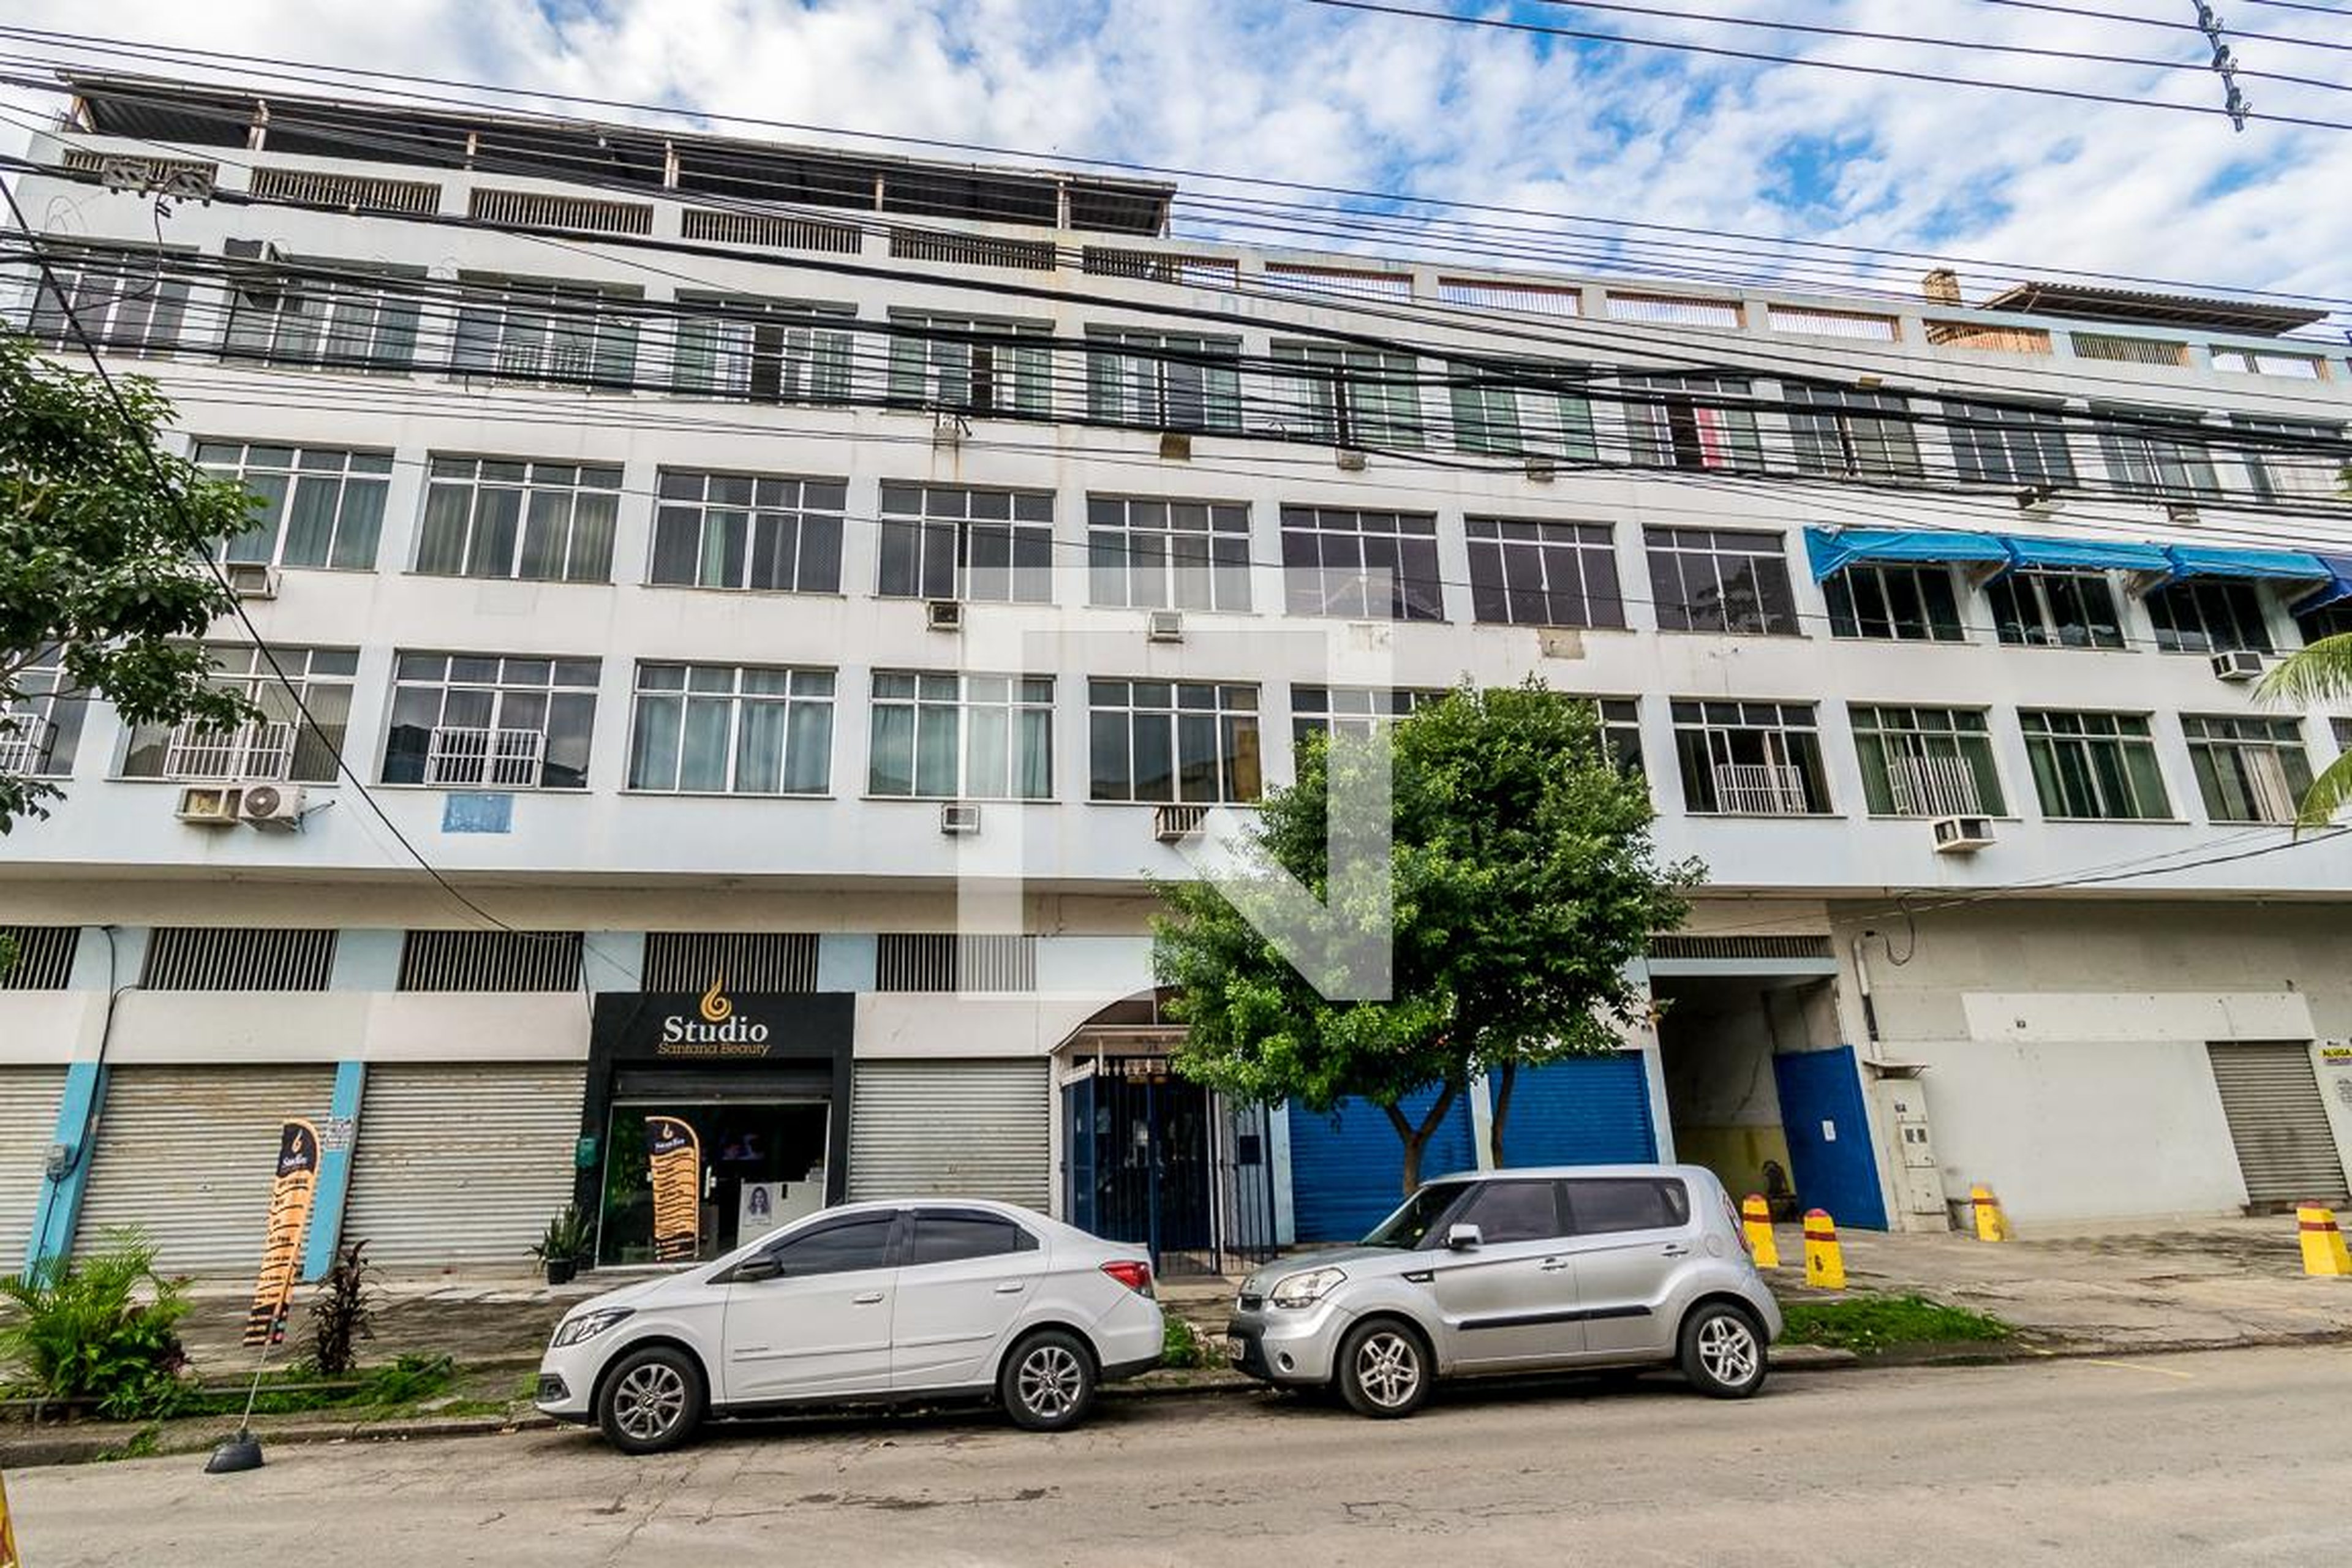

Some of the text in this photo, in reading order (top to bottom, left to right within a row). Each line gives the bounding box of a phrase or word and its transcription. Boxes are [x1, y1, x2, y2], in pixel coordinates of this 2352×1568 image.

[663, 1016, 769, 1042] Studio
[657, 1042, 771, 1057] Santana Beauty
